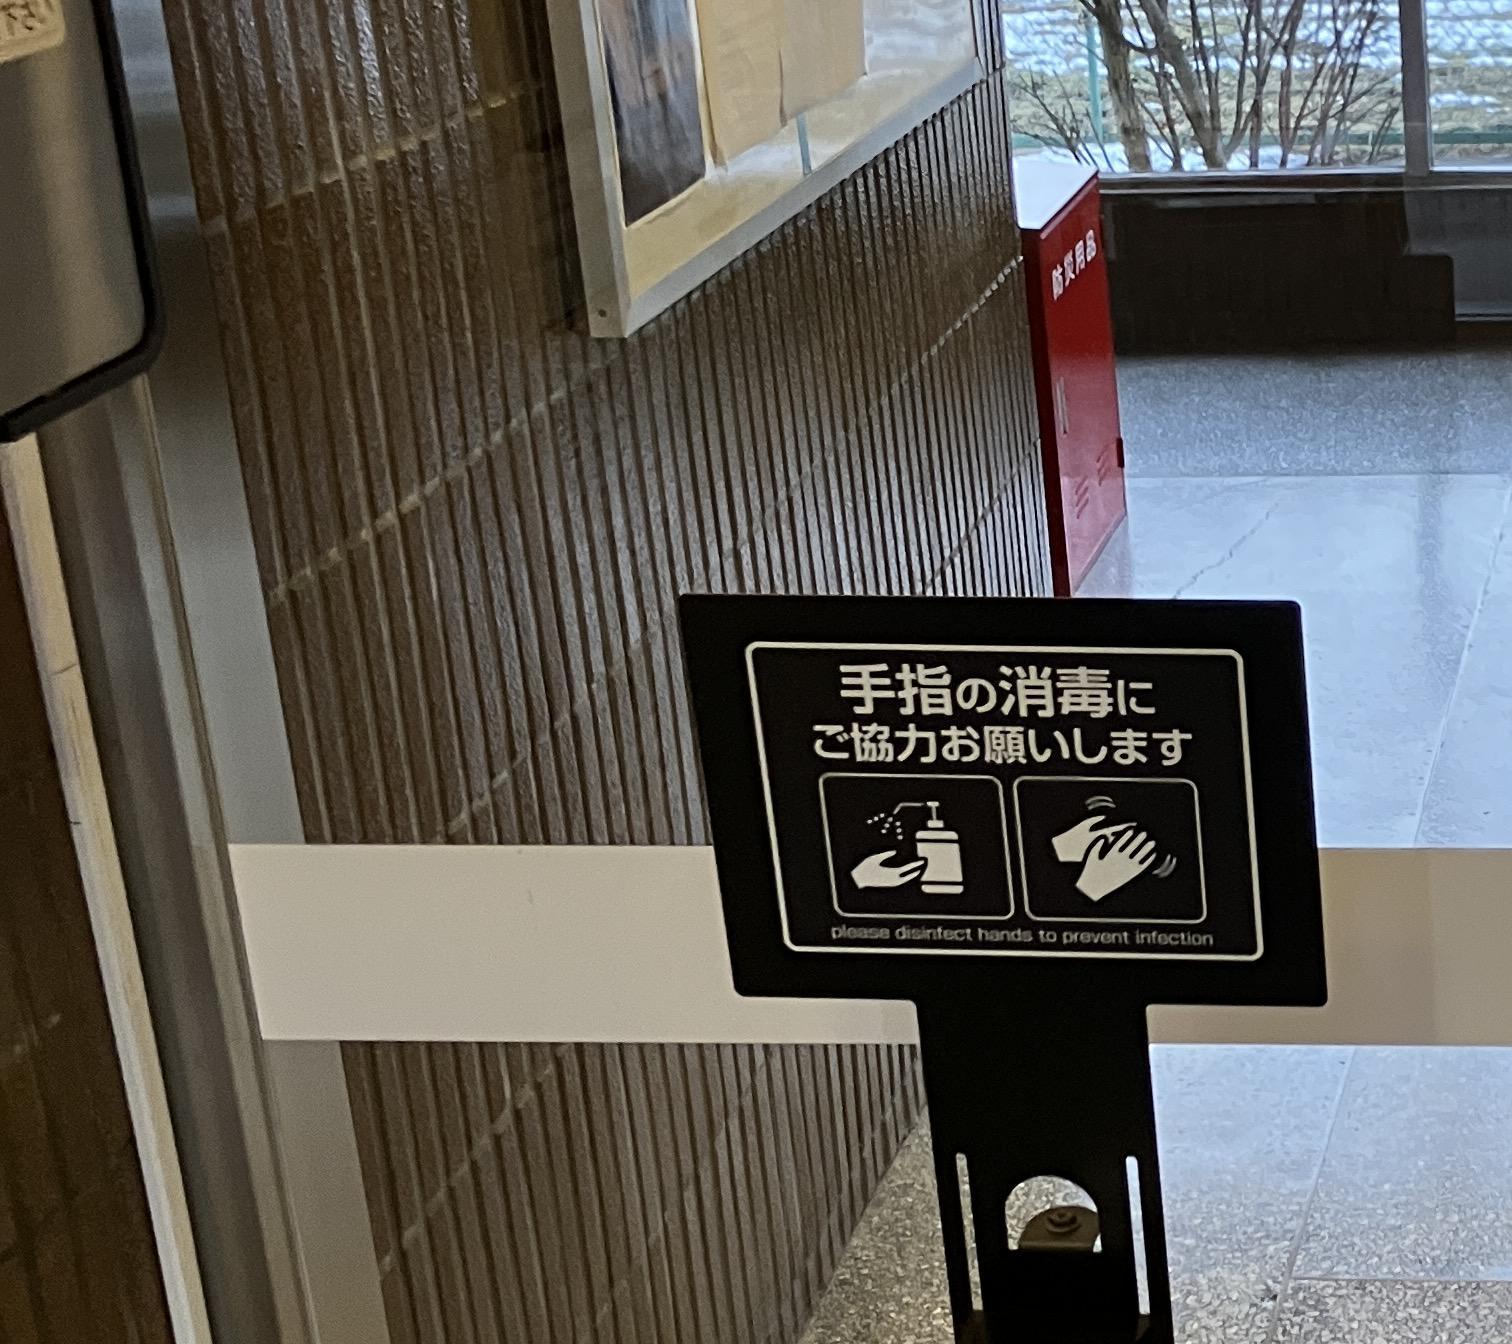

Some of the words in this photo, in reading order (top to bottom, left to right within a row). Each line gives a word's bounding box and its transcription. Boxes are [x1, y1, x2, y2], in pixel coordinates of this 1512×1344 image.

[840, 663, 1156, 719] 手指の消毒に
[812, 723, 1193, 767] ご協力お願いします
[831, 925, 890, 940] please
[895, 926, 973, 941] disinfect
[978, 927, 1033, 942] hands
[1039, 930, 1057, 943] to
[1062, 931, 1130, 945] prevent
[1135, 931, 1213, 947] infection
